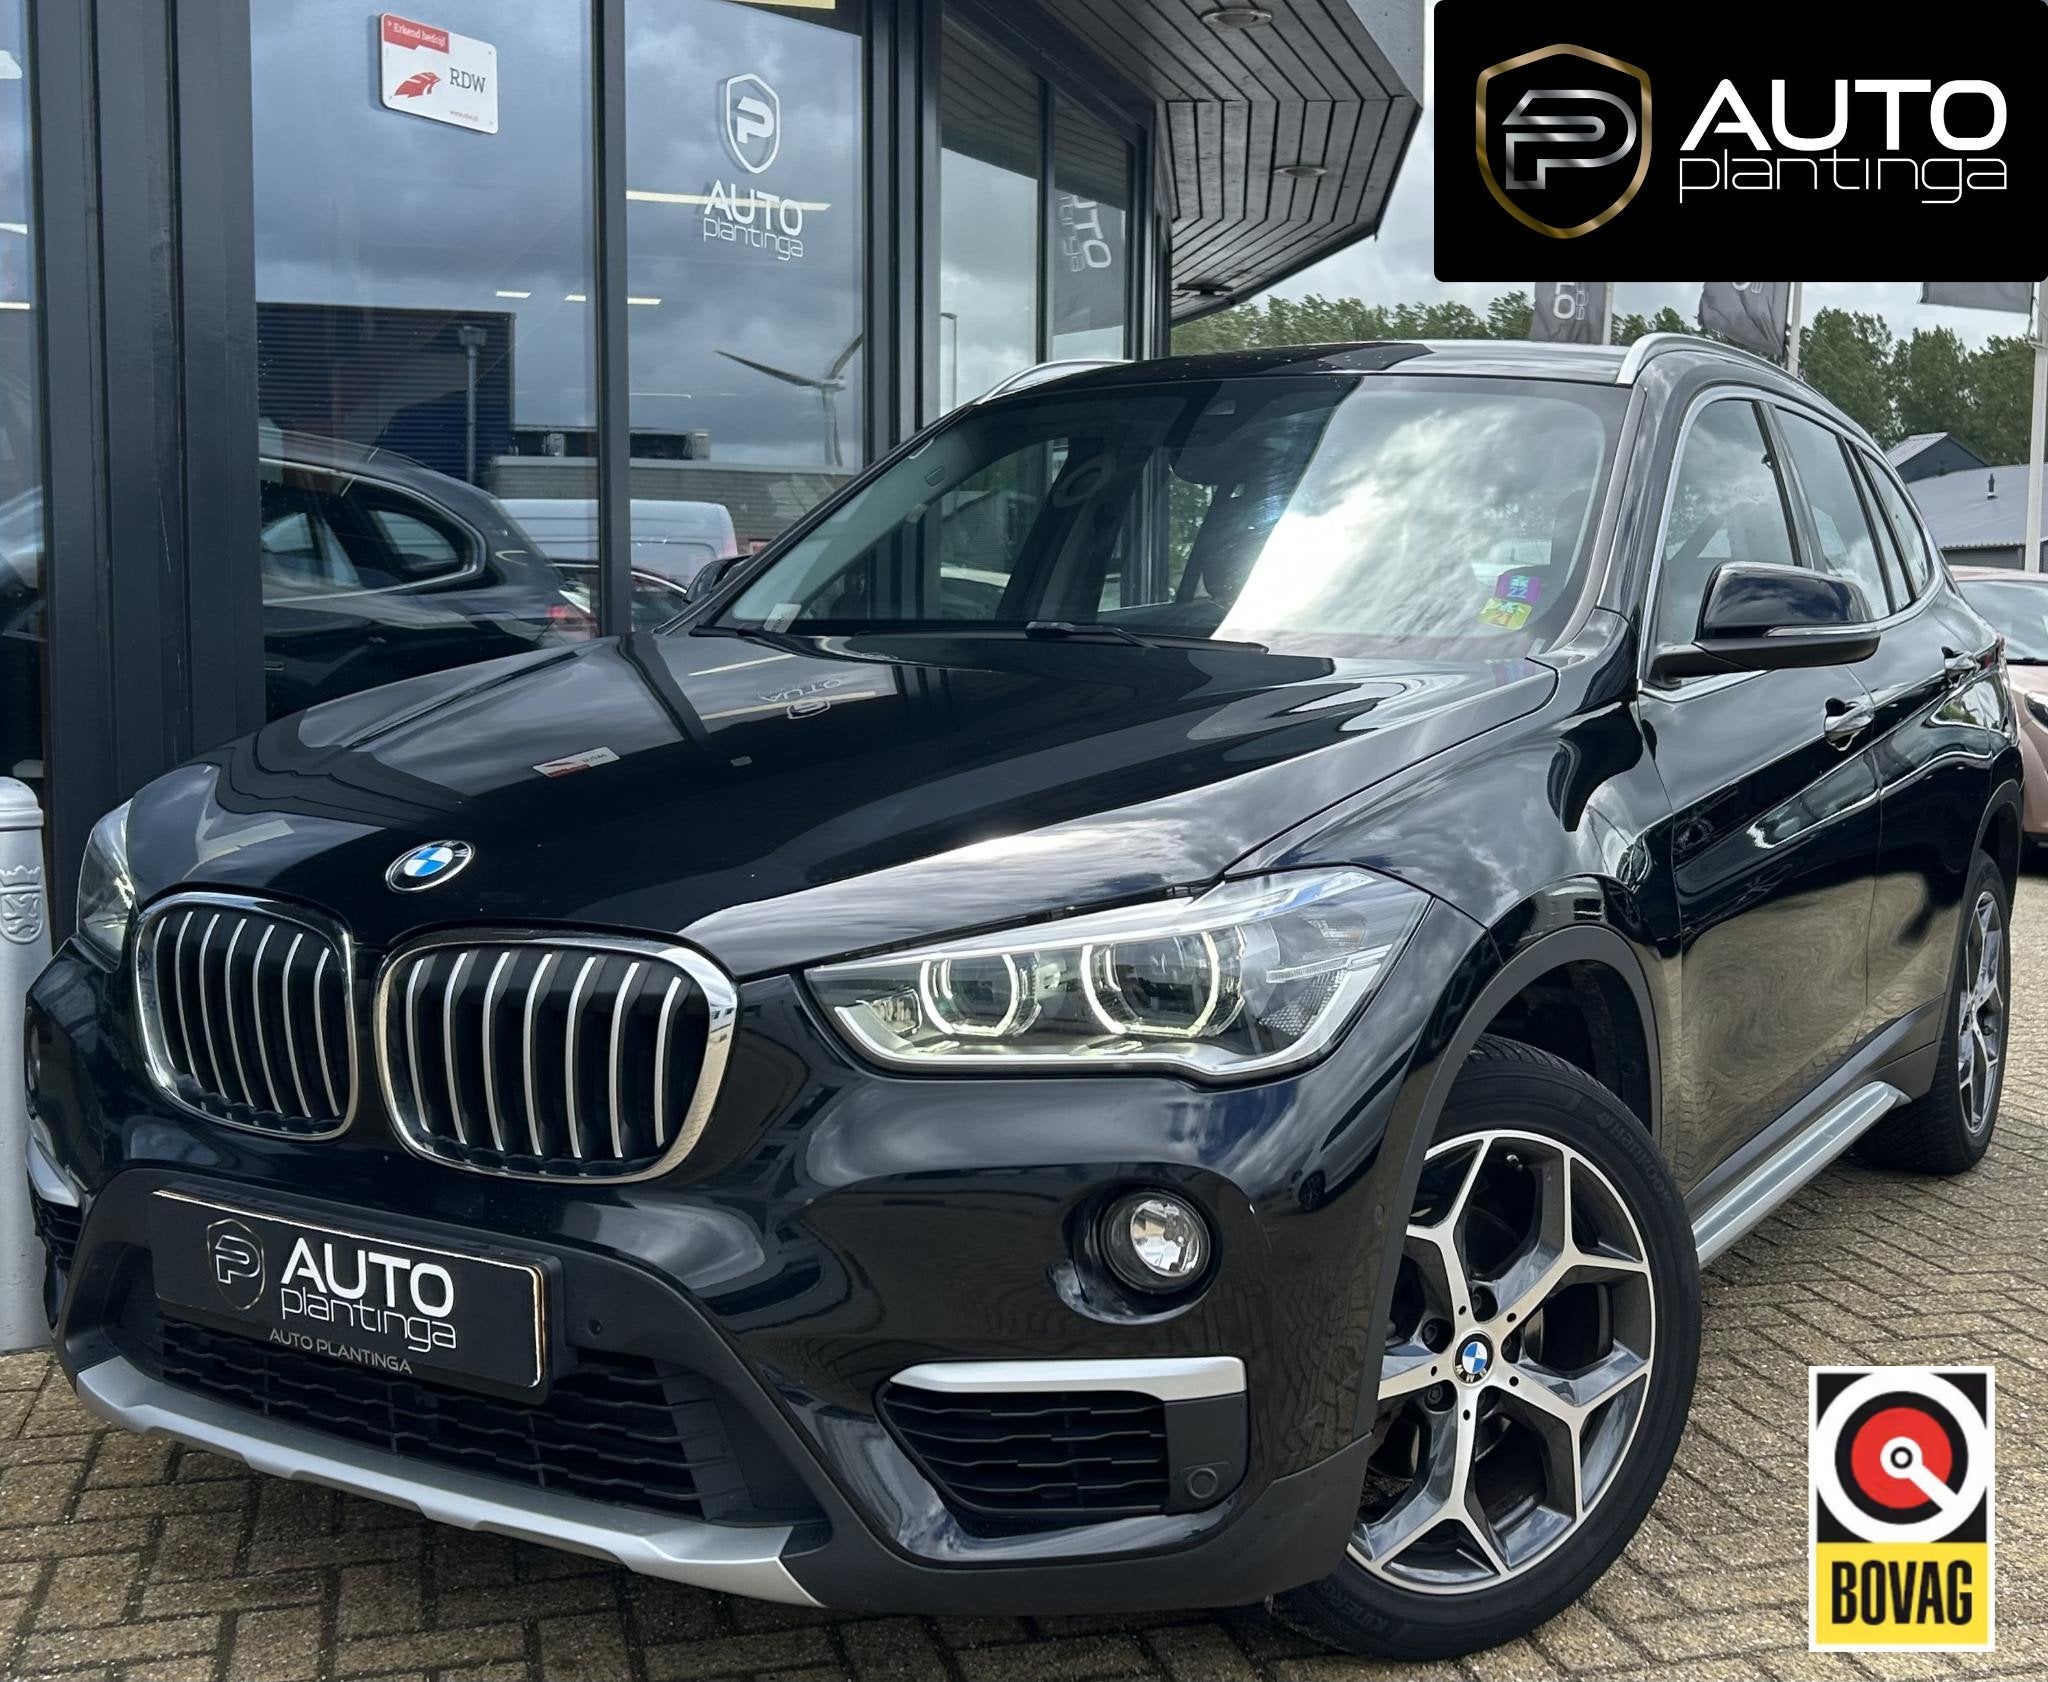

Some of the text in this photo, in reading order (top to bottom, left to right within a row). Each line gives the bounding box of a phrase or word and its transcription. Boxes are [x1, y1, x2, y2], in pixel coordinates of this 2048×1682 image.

[449, 67, 486, 94] RDW
[704, 179, 803, 236] AUTO
[703, 216, 804, 261] plantinga
[280, 1237, 454, 1318] AUTO
[280, 1288, 457, 1353] plantinga
[269, 1327, 413, 1375] AUTO PLANTINGA
